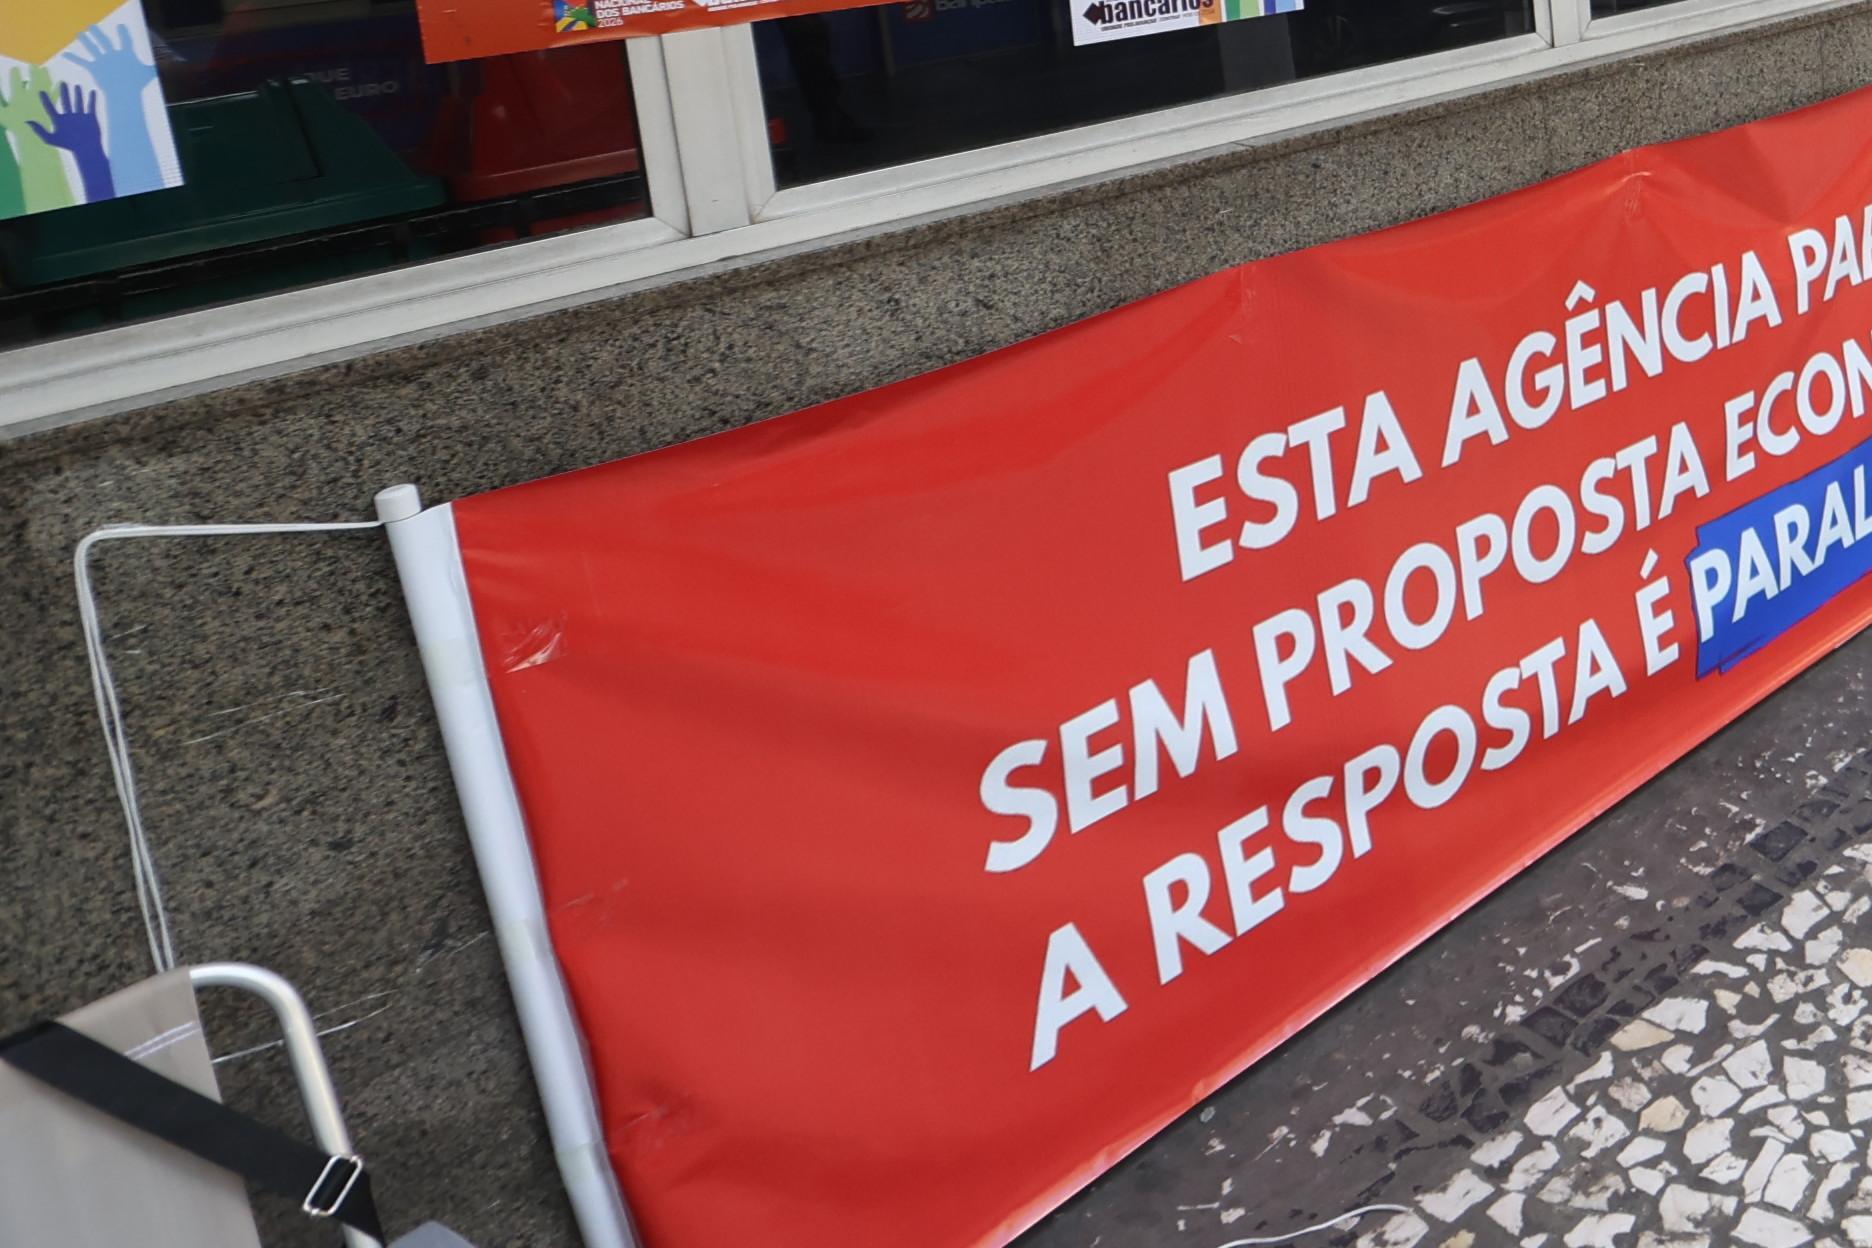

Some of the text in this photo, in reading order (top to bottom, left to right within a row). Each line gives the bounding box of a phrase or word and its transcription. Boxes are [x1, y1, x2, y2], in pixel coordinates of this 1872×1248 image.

[596, 9, 619, 19] DOS
[1166, 391, 1421, 582] ESTA
[1441, 252, 1782, 468] AGÊNCIA
[979, 651, 1238, 873] SEM
[1251, 420, 1708, 733] PROPOSTA
[1030, 922, 1127, 1071] A
[1141, 649, 1627, 986] RESPOSTA
[1640, 551, 1679, 677] É
